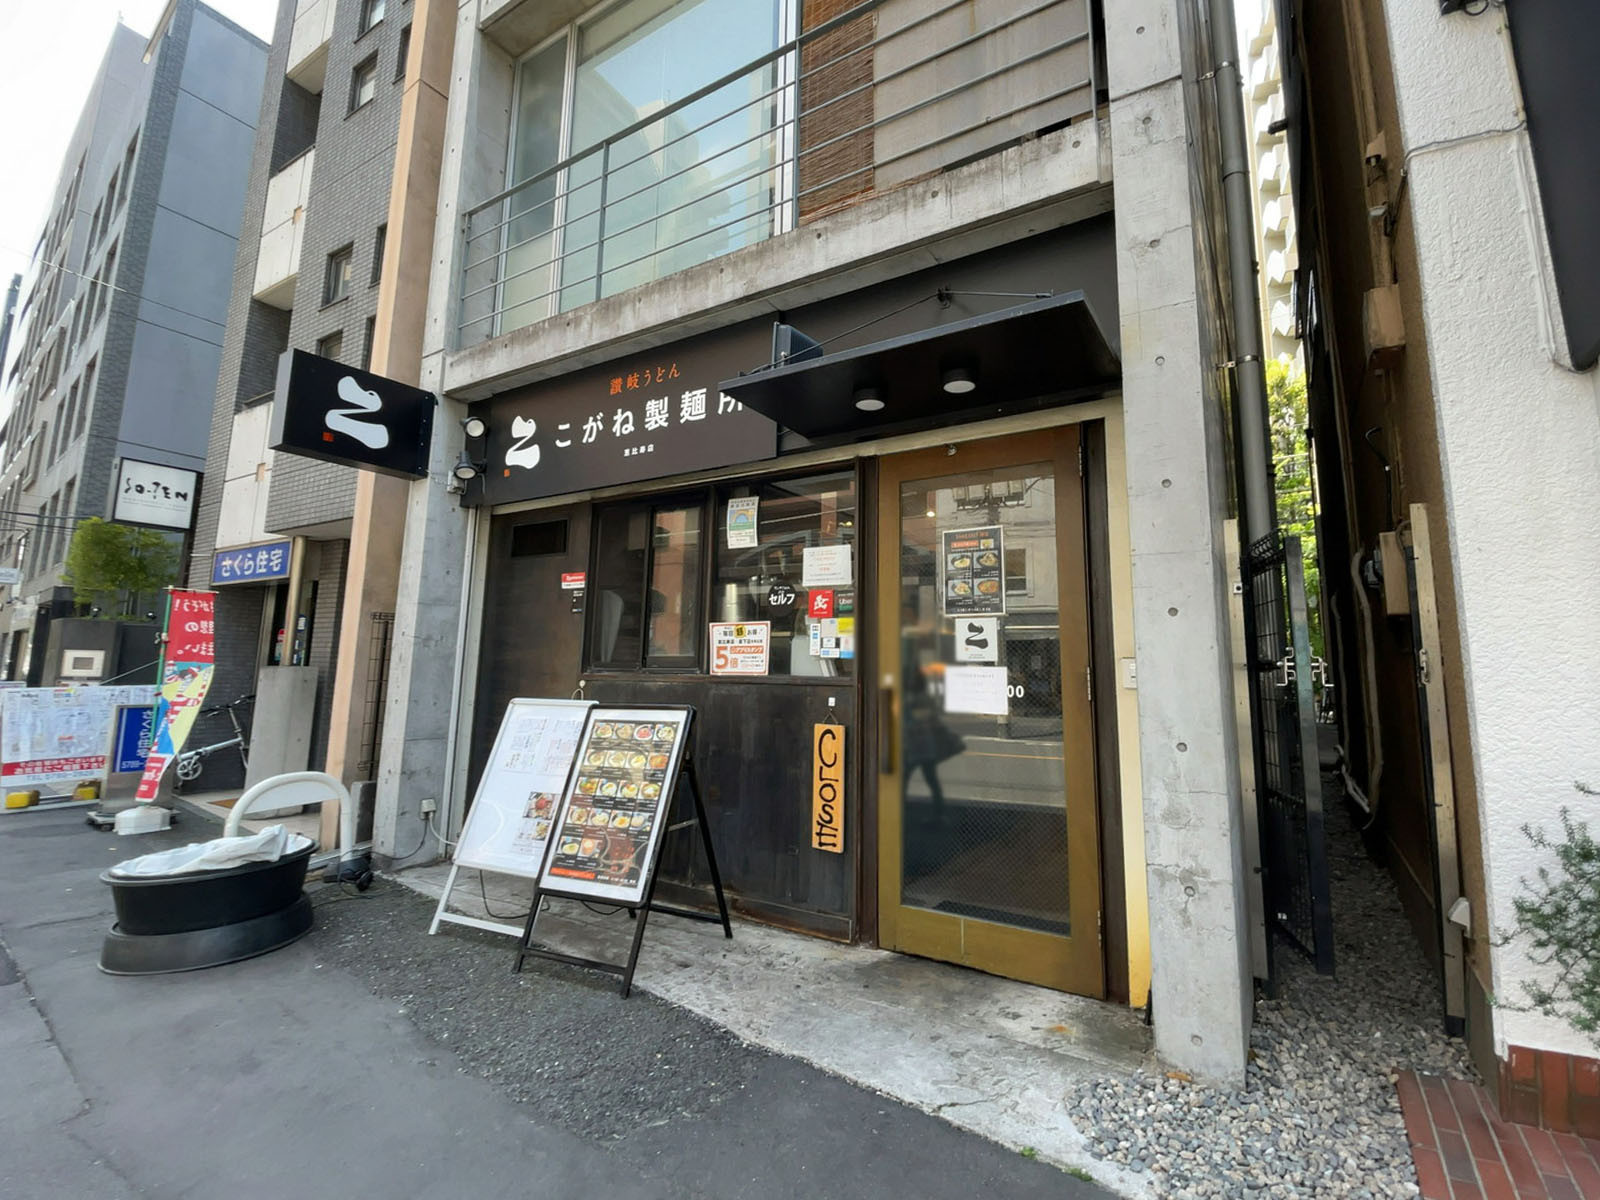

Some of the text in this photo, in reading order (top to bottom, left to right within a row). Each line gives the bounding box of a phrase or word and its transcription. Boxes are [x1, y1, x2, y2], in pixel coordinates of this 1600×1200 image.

[221, 549, 283, 577] さくら住宅
[769, 593, 795, 606] セルフ
[815, 728, 839, 848] CLOSE
